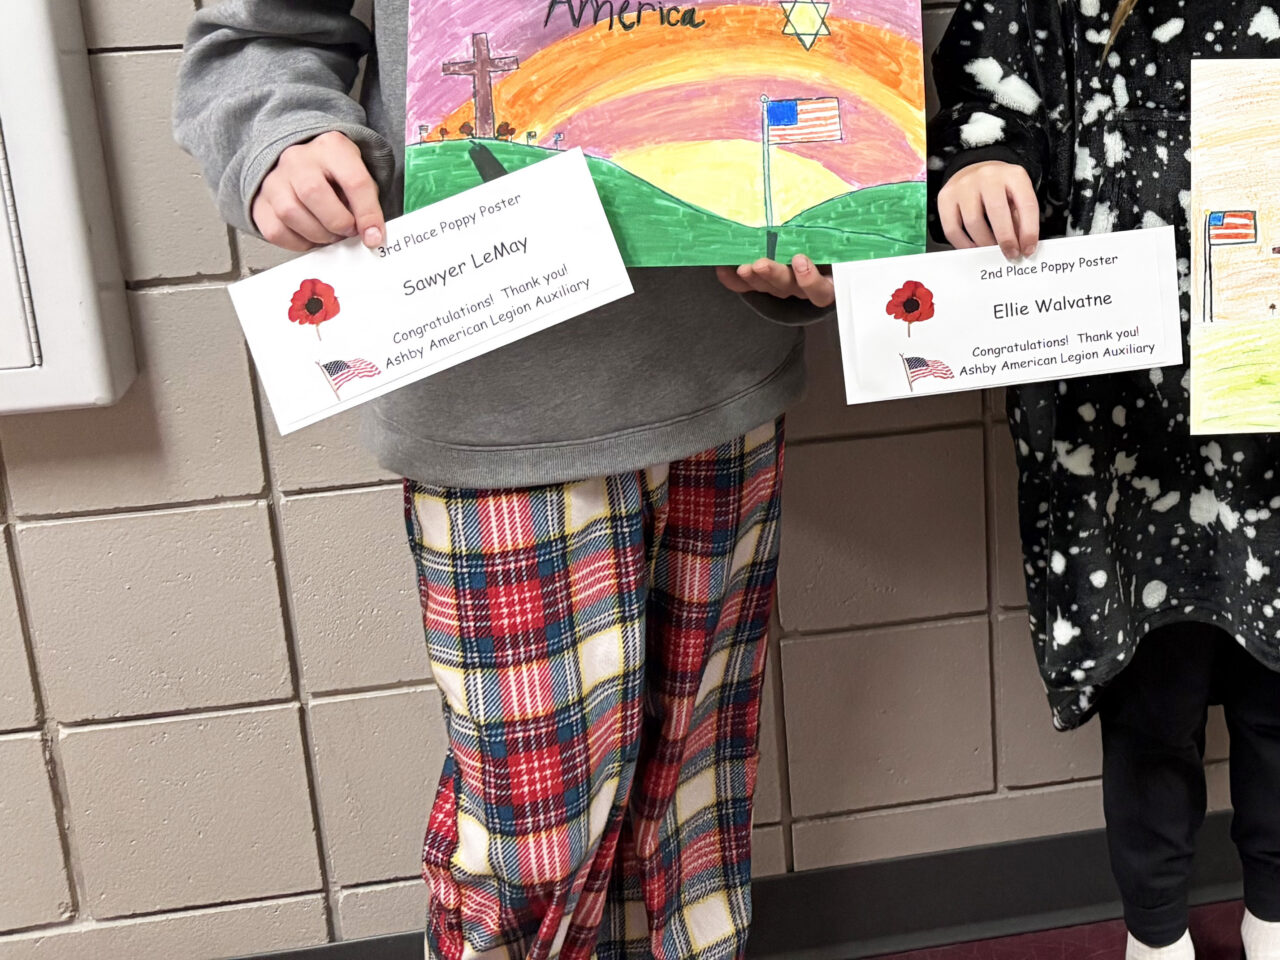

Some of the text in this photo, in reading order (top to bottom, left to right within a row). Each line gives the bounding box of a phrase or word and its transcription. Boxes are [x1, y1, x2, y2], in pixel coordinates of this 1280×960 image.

[377, 194, 521, 258] 3rd Place Poppy Poster
[403, 237, 528, 297] Sawyer LeMay
[980, 254, 1118, 280] 2nd Place Poppy Poster
[385, 278, 591, 369] Ashby American Legion Auxiliary
[392, 263, 569, 344] Congratulations! Thank you!
[993, 293, 1113, 319] Ellie Walvatne
[959, 342, 1156, 376] Ashby American Legion Auxiliary
[972, 326, 1140, 359] Congratulations! Thank you!
